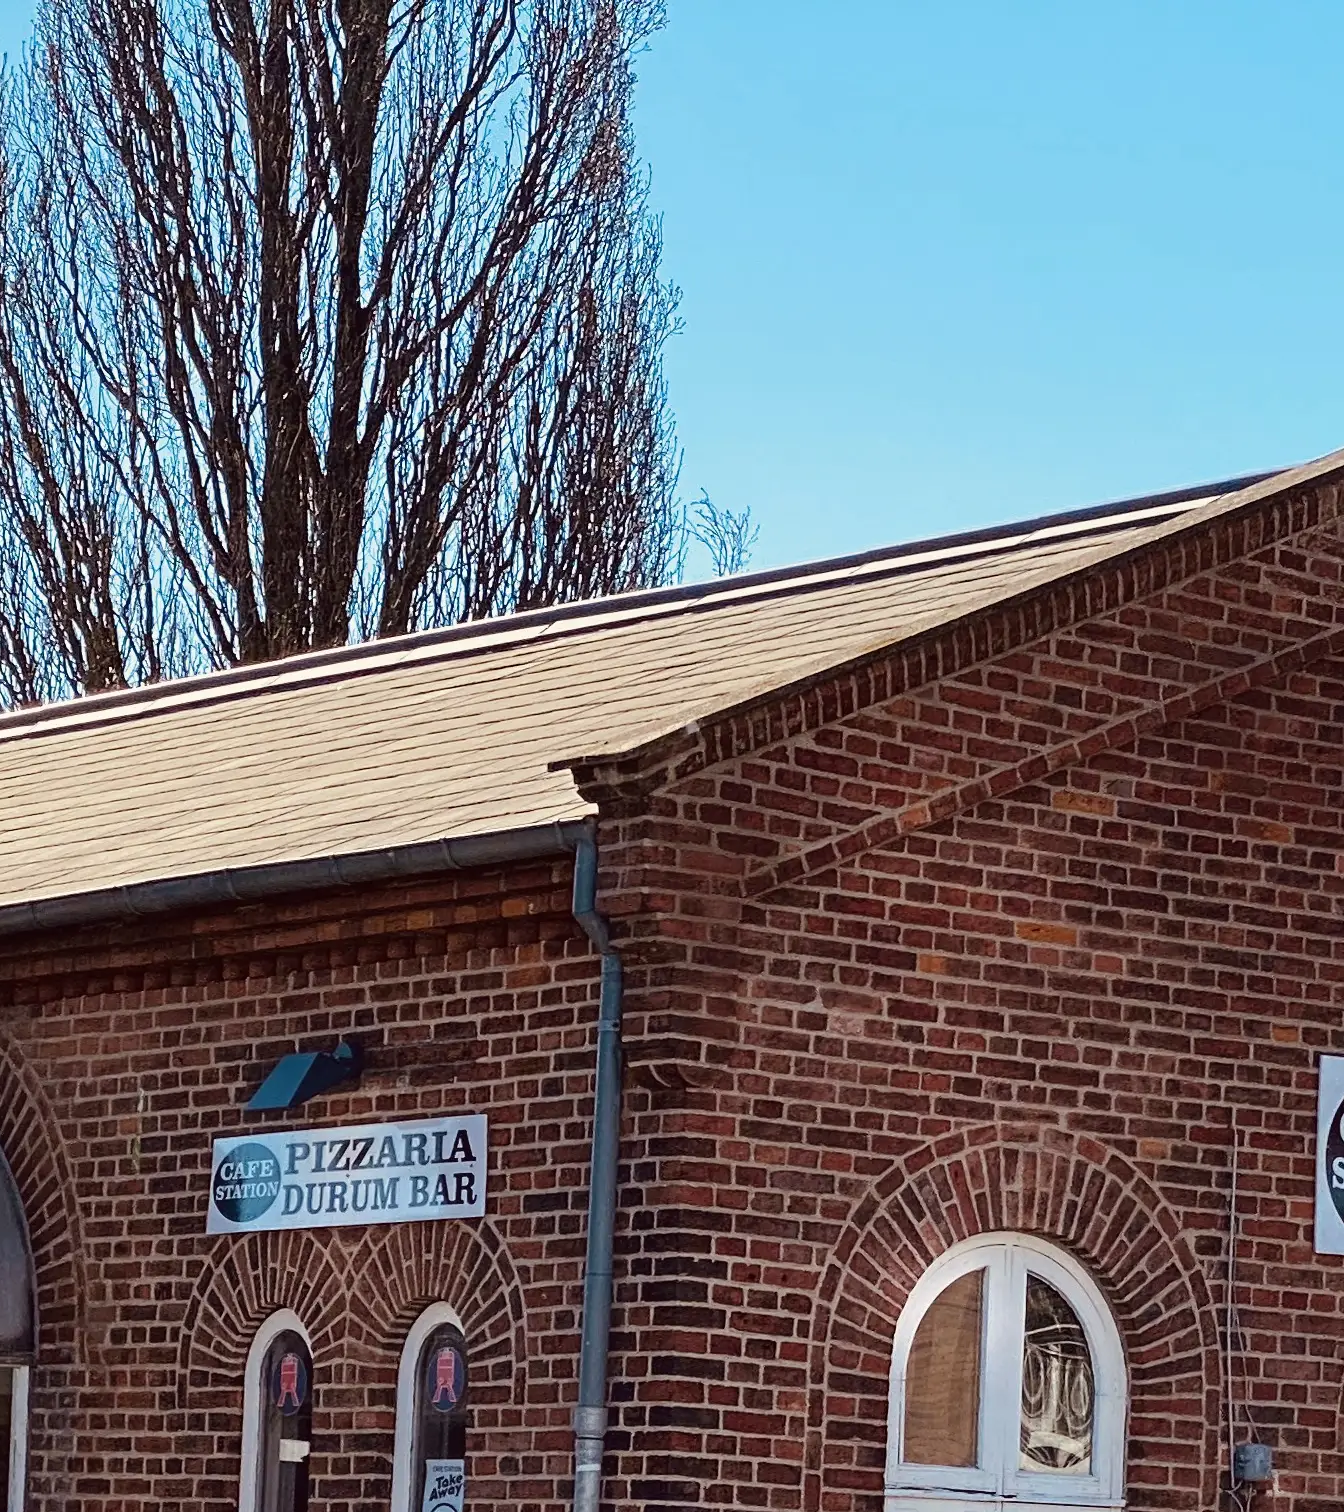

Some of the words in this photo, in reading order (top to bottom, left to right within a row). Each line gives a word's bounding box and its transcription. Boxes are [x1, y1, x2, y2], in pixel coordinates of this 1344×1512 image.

[283, 1129, 477, 1175] PIZZARIA
[220, 1160, 274, 1182] CAFE
[216, 1181, 279, 1200] STATION
[280, 1176, 400, 1216] DURUM
[408, 1172, 478, 1208] BAR
[436, 1473, 463, 1489] Take
[429, 1483, 464, 1501] Away
